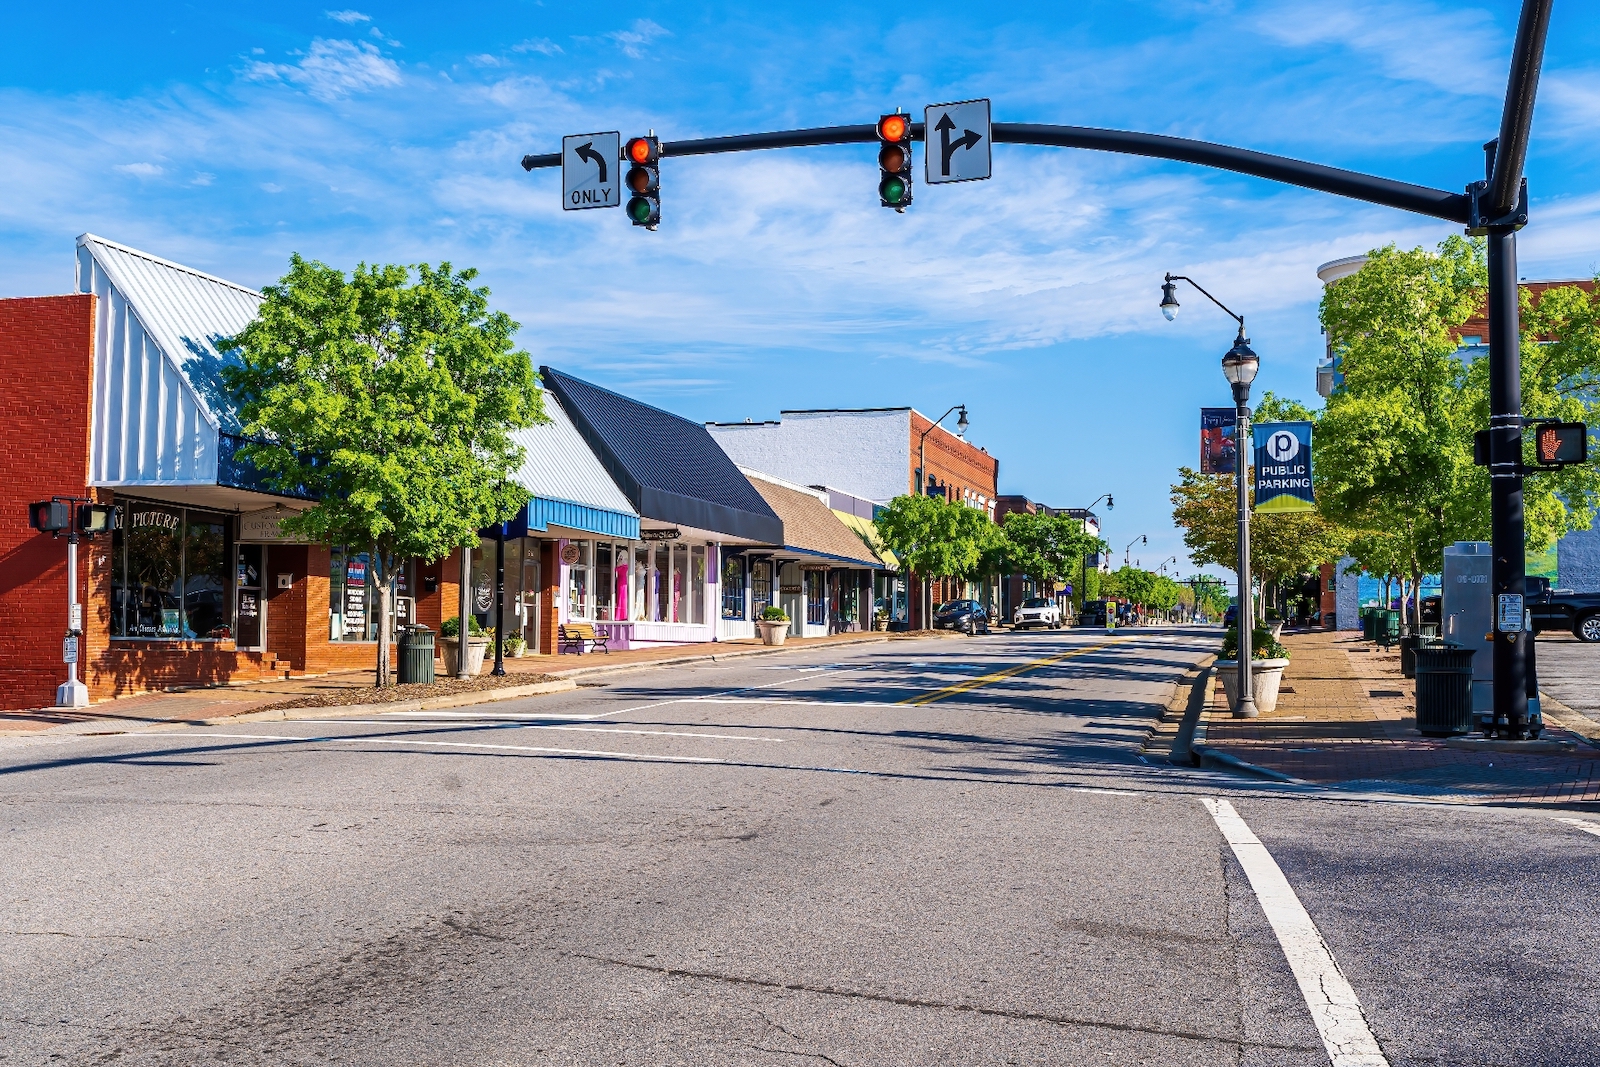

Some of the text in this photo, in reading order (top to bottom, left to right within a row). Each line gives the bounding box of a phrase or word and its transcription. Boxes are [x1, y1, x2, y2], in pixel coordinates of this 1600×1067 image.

[571, 188, 612, 205] ONLY
[1262, 464, 1305, 477] PUBLIC
[1258, 478, 1310, 490] PARKING
[132, 511, 180, 531] PICTURE
